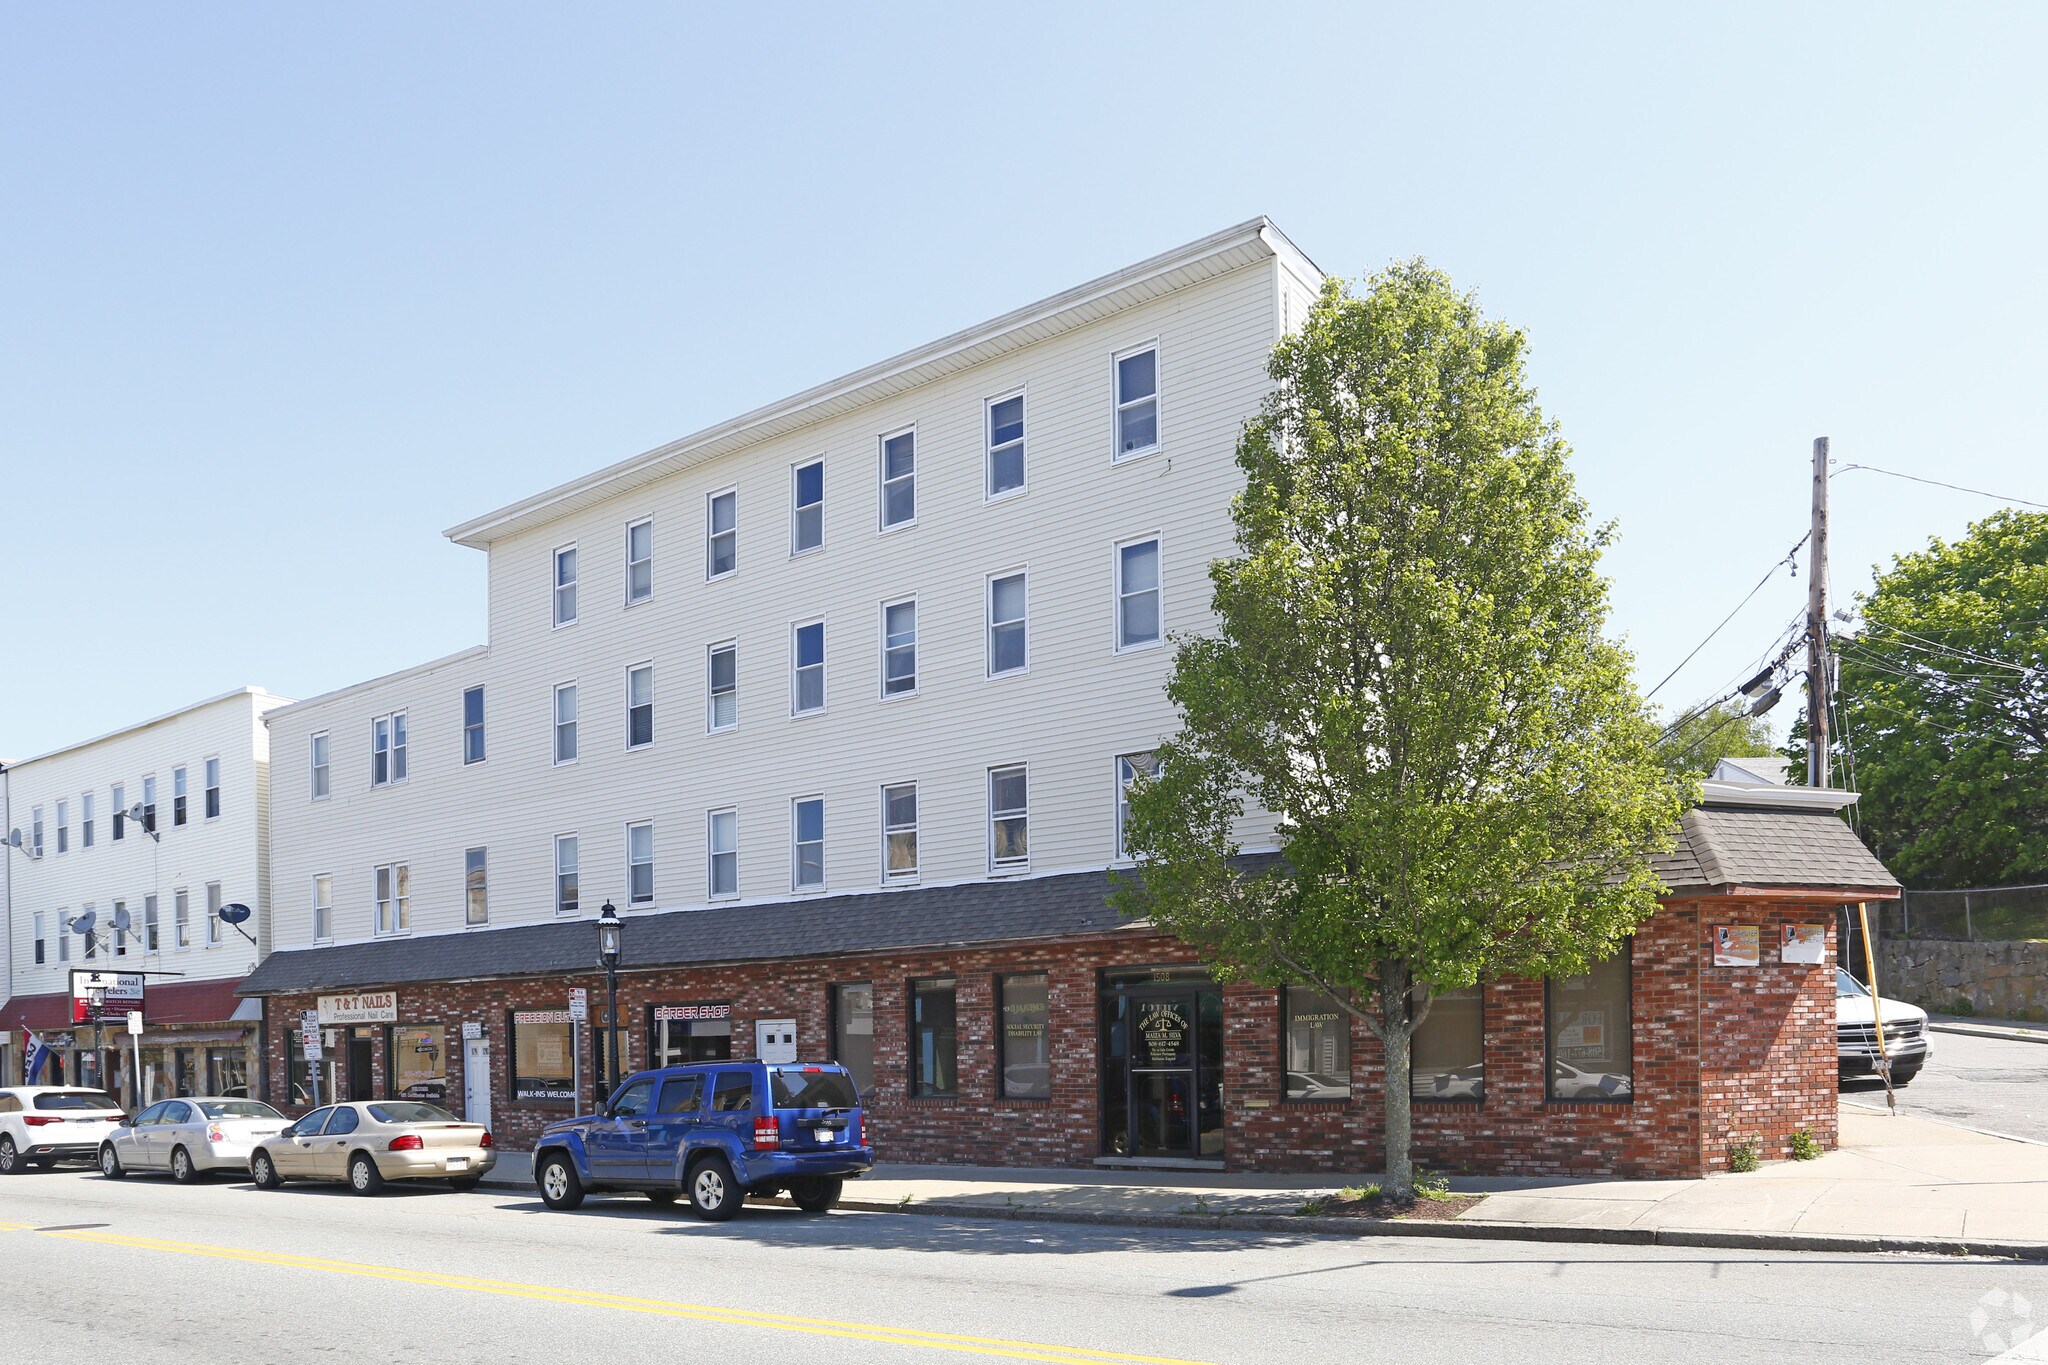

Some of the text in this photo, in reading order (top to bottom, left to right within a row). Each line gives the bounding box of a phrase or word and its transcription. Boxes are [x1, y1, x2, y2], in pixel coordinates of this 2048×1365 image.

[1730, 929, 1757, 937] COMPUTER
[79, 976, 138, 986] Innational
[1153, 973, 1170, 982] 1508
[335, 994, 392, 1010] T & T NAILS
[334, 1010, 394, 1021] Professional Nail Care
[514, 1012, 553, 1023] PRECISION
[655, 1005, 730, 1020] BARBER SHOP
[1294, 1013, 1339, 1021] IMMIGRATION
[1139, 1010, 1189, 1031] THE LAW OFFICES OF
[1310, 1021, 1323, 1029] LAW
[517, 1090, 575, 1099] WALK-INS WELCOME
